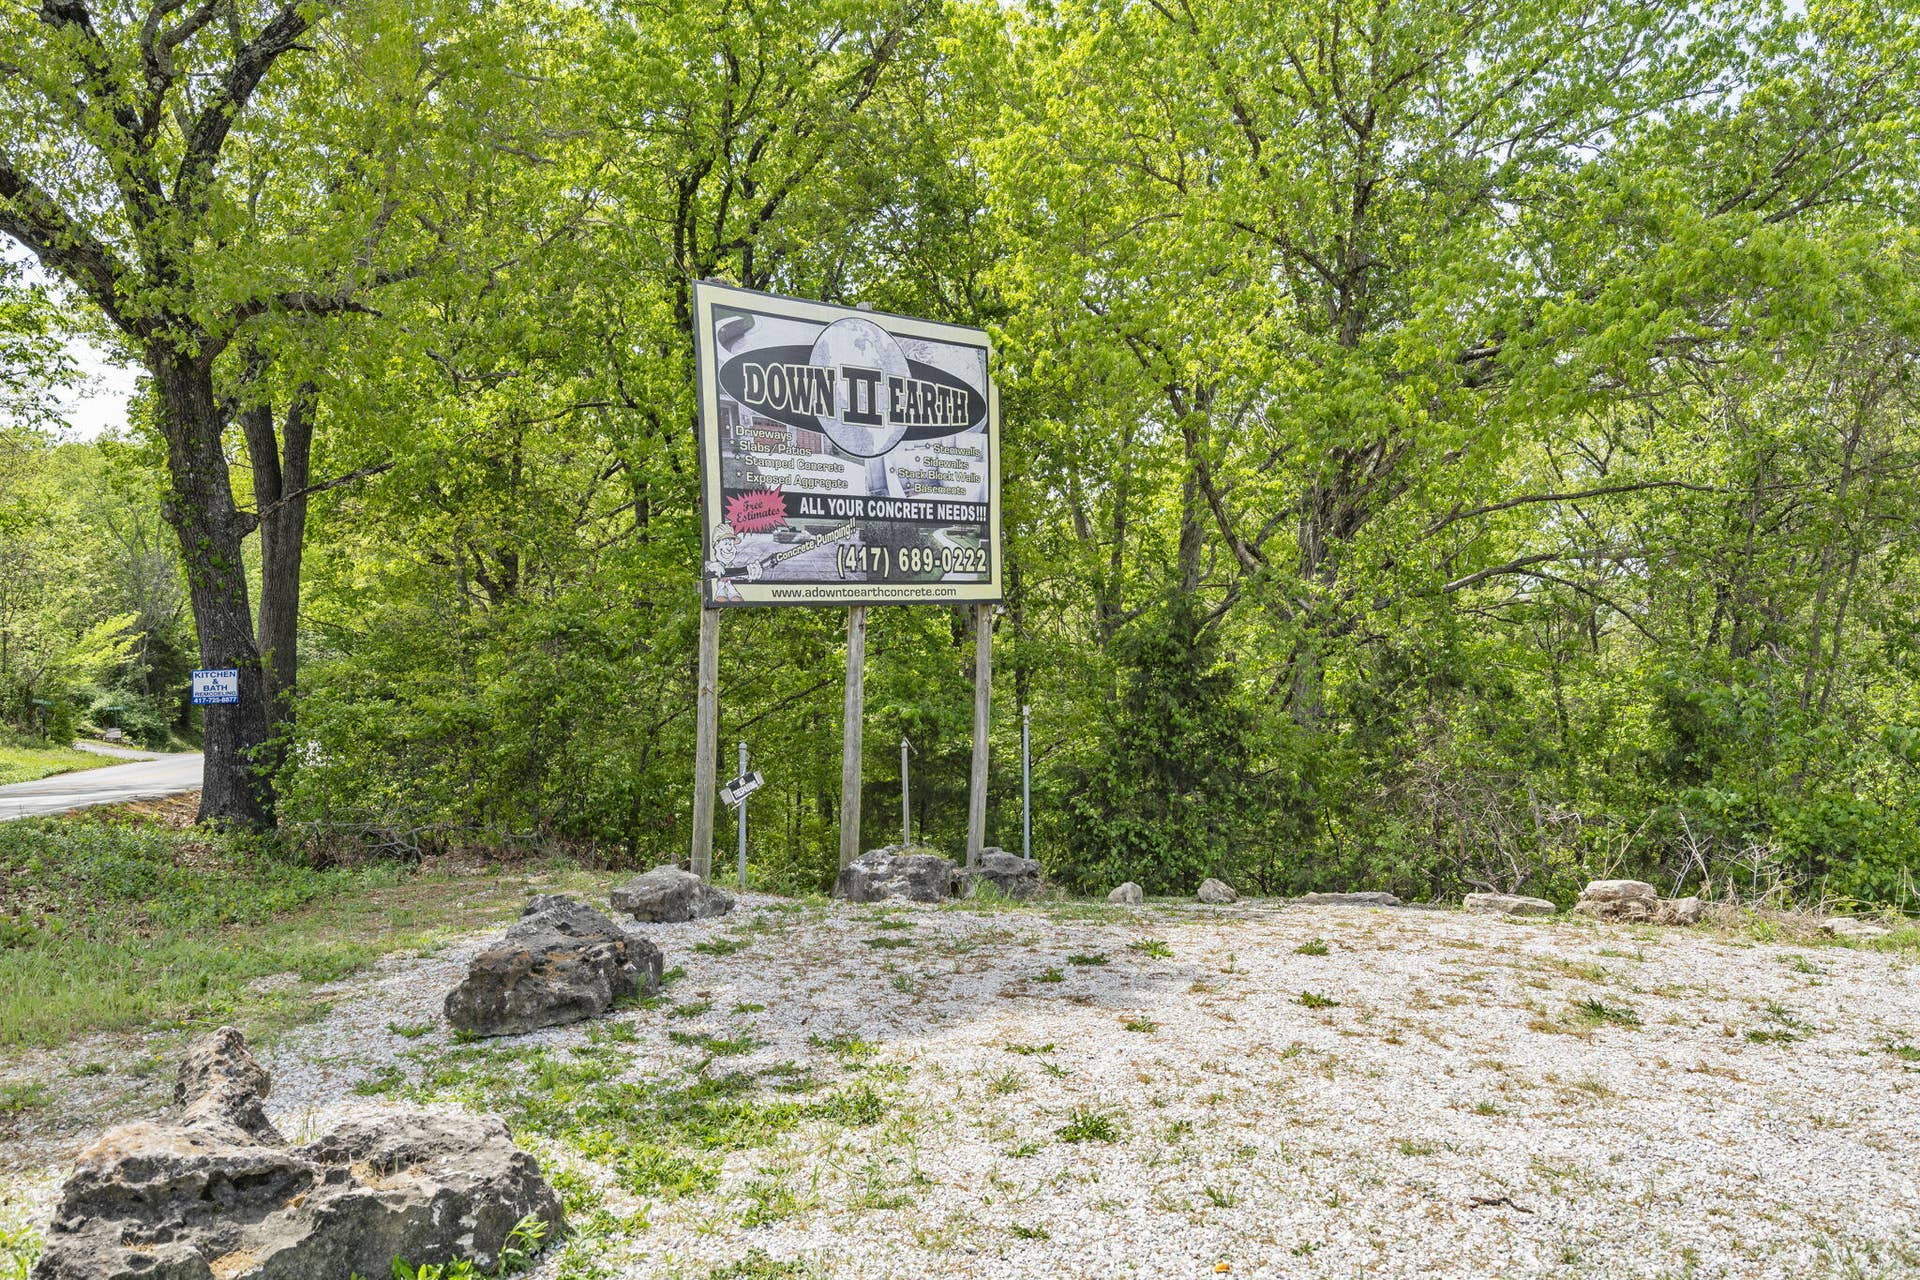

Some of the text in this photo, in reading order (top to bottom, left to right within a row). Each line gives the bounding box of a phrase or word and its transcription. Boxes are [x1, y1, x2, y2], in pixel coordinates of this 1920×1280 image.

[743, 362, 836, 419] DOWN
[887, 376, 969, 427] EARTH
[736, 425, 793, 441] Driveways
[739, 440, 812, 456] Slabs/Patios
[933, 443, 982, 457] Stemwalls
[745, 455, 845, 472] Stamped Concrete
[923, 457, 970, 470] Sidewalks
[746, 472, 848, 490] Exposed Aggregate
[897, 467, 982, 483] Stack Block Walls
[914, 483, 967, 495] Basements
[743, 501, 764, 512] Free
[800, 497, 987, 522] ALL YOUR CONCRETE NEEDS!!!
[736, 508, 781, 523] Estimates
[776, 517, 856, 562] Concrete Pumping!!
[836, 544, 987, 579] (417) 689-0222
[772, 586, 957, 599] www.adowntoearthconcrete.com
